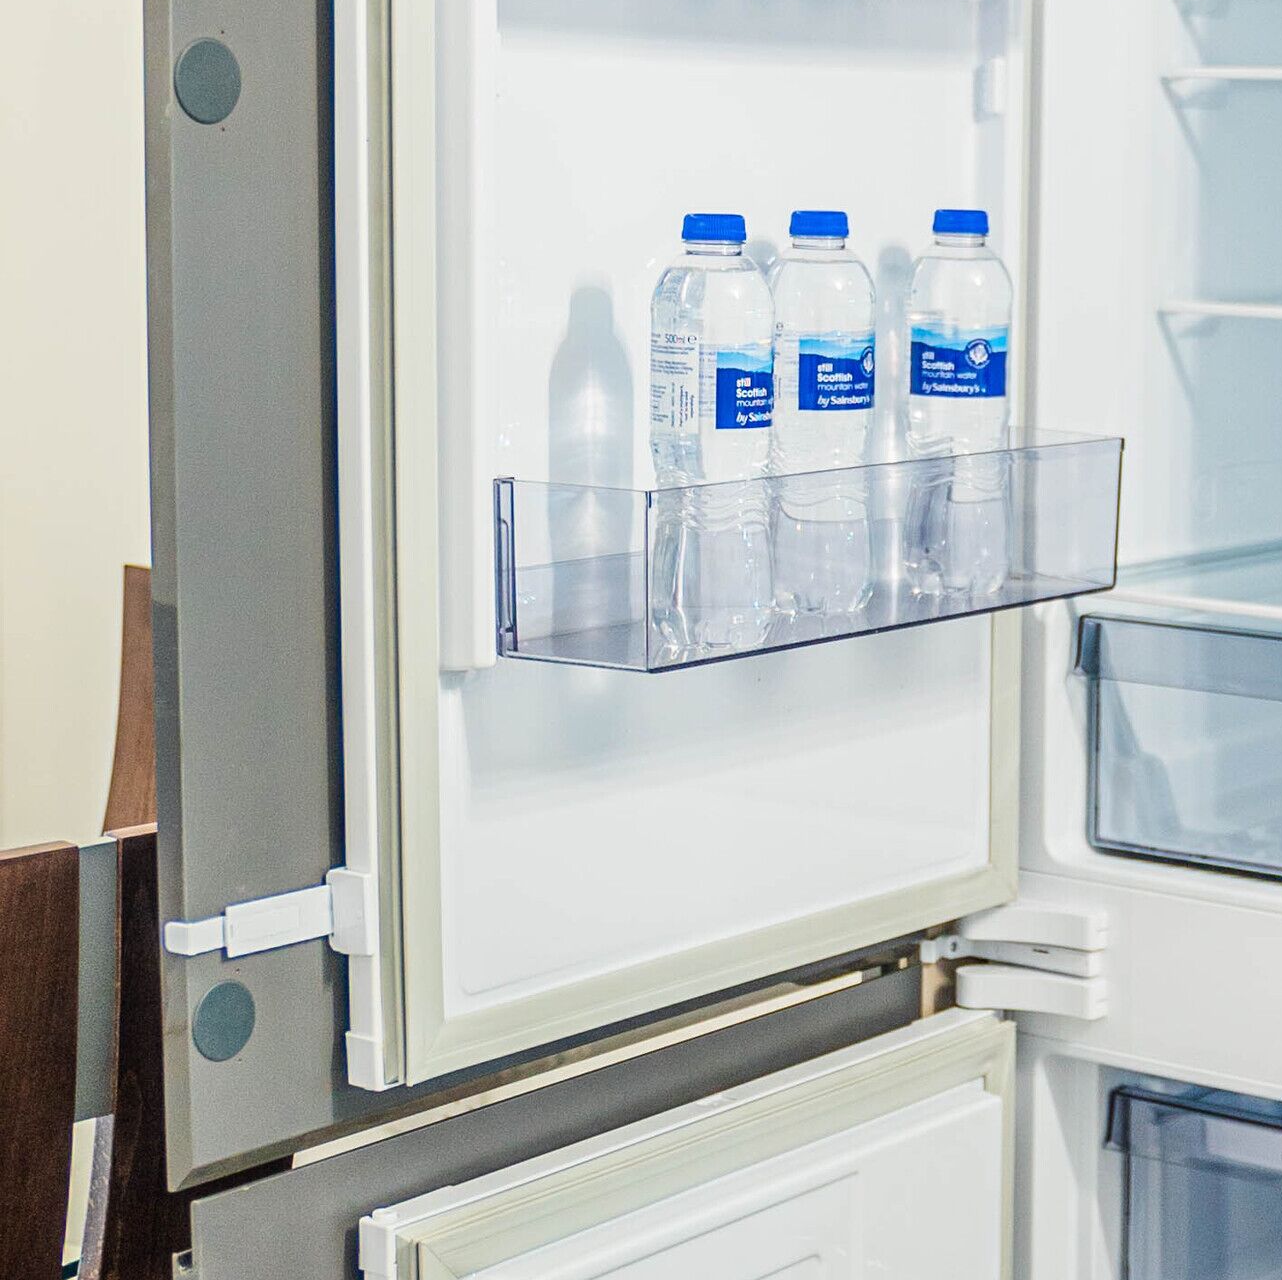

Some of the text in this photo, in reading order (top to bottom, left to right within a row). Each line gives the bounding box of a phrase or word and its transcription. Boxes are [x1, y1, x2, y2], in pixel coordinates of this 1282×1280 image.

[817, 363, 833, 372] still
[921, 361, 955, 371] Scottish
[817, 373, 853, 382] Scottish
[921, 371, 955, 379] mountain
[736, 377, 751, 387] still
[817, 383, 853, 391] mountain
[736, 387, 767, 398] Scottish
[932, 382, 980, 394] Sainsbury's
[817, 395, 830, 408] by
[736, 411, 748, 426] by
